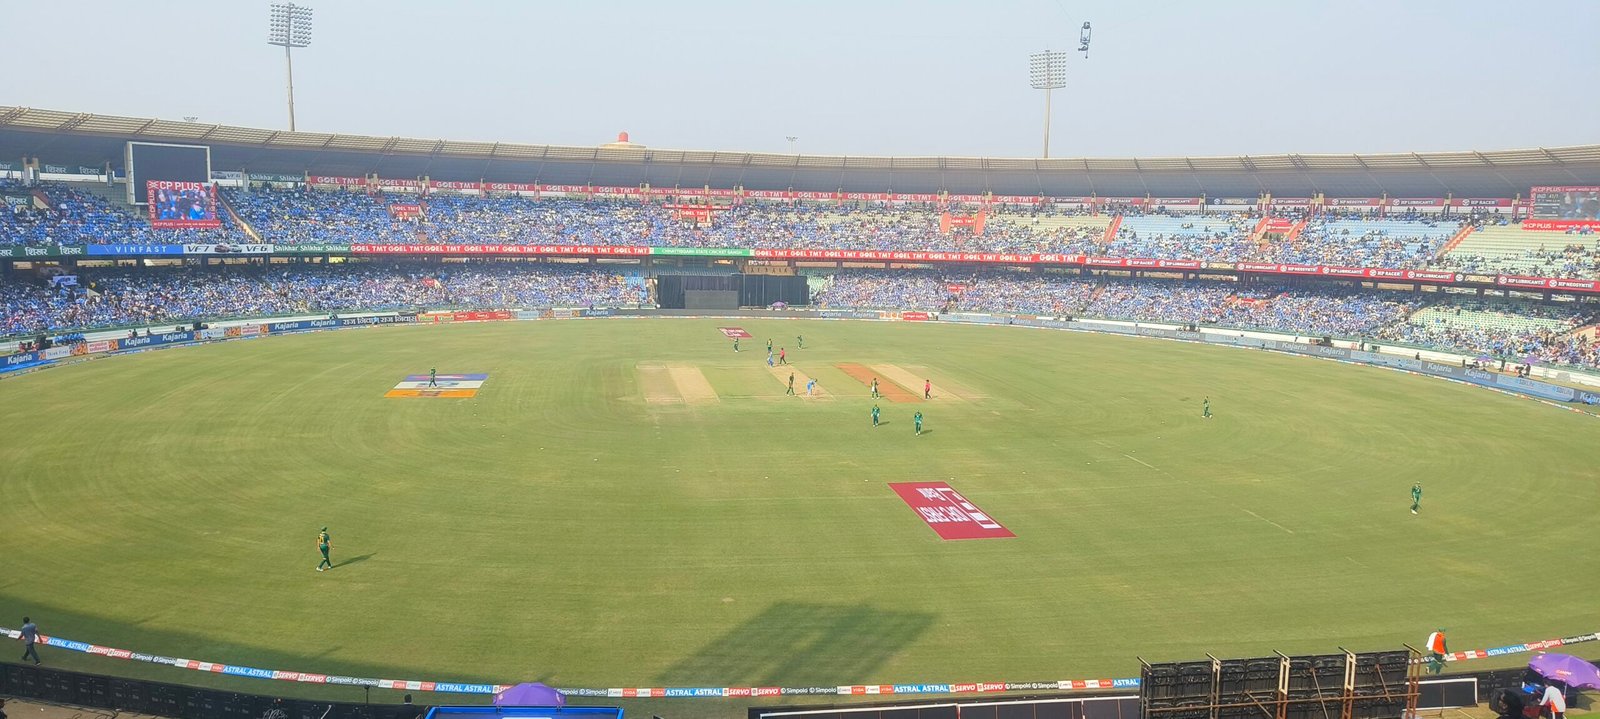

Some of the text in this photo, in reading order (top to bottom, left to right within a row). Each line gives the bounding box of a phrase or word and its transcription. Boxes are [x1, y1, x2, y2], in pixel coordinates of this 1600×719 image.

[160, 181, 200, 190] CP PLUS
[274, 321, 299, 330] Kajaria
[310, 319, 336, 328] Kajaria
[162, 330, 188, 342] Kajaria
[124, 336, 150, 348] Kajaria
[7, 353, 33, 364] Kajaria
[1427, 362, 1452, 375] Kajaria
[1464, 368, 1490, 381] Kajaria
[48, 638, 87, 651] ASTRAL ASTRAL
[1488, 645, 1526, 656] ASTRAL ASTRAL
[223, 666, 272, 678] ASTRAL ASTRAL
[278, 672, 324, 682] SERVO SERVO
[436, 682, 462, 692] ASTRAL
[464, 684, 492, 693] ASTRAL
[1114, 678, 1138, 686] ASTRAL
